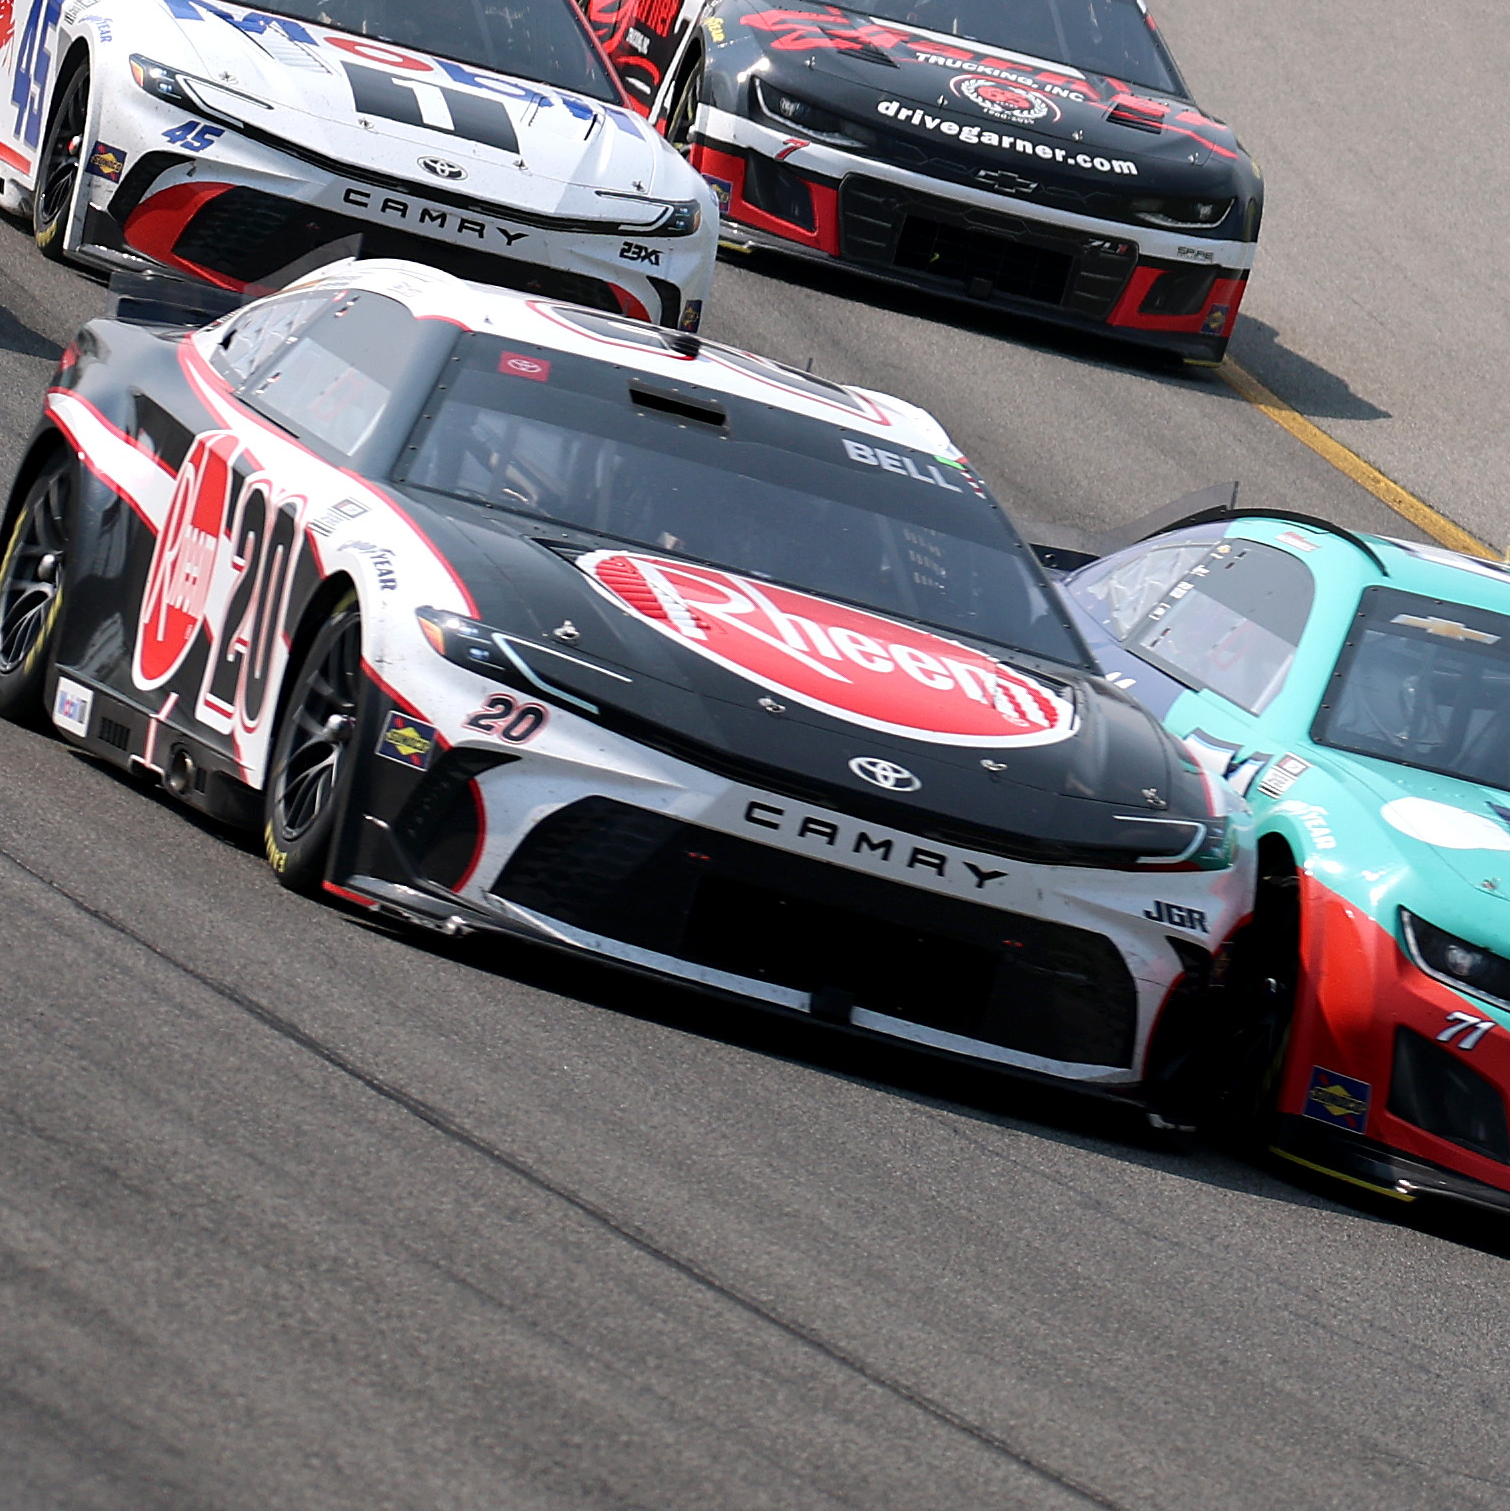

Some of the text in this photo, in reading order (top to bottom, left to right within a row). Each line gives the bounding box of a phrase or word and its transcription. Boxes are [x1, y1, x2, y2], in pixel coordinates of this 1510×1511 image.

[915, 51, 1086, 104] TRUCKING, INC
[90, 152, 123, 174] SUNOCO
[161, 120, 227, 153] 45
[774, 138, 811, 161] 7
[877, 98, 1139, 177] drivegarner.com
[342, 187, 529, 248] CAMRY
[842, 439, 962, 493] BELL
[197, 477, 308, 734] 20
[617, 554, 1055, 726] Rheem
[468, 694, 549, 744] 20
[744, 799, 1010, 890] CAMRY
[1144, 900, 1209, 933] JGR
[1435, 1011, 1496, 1051] 71
